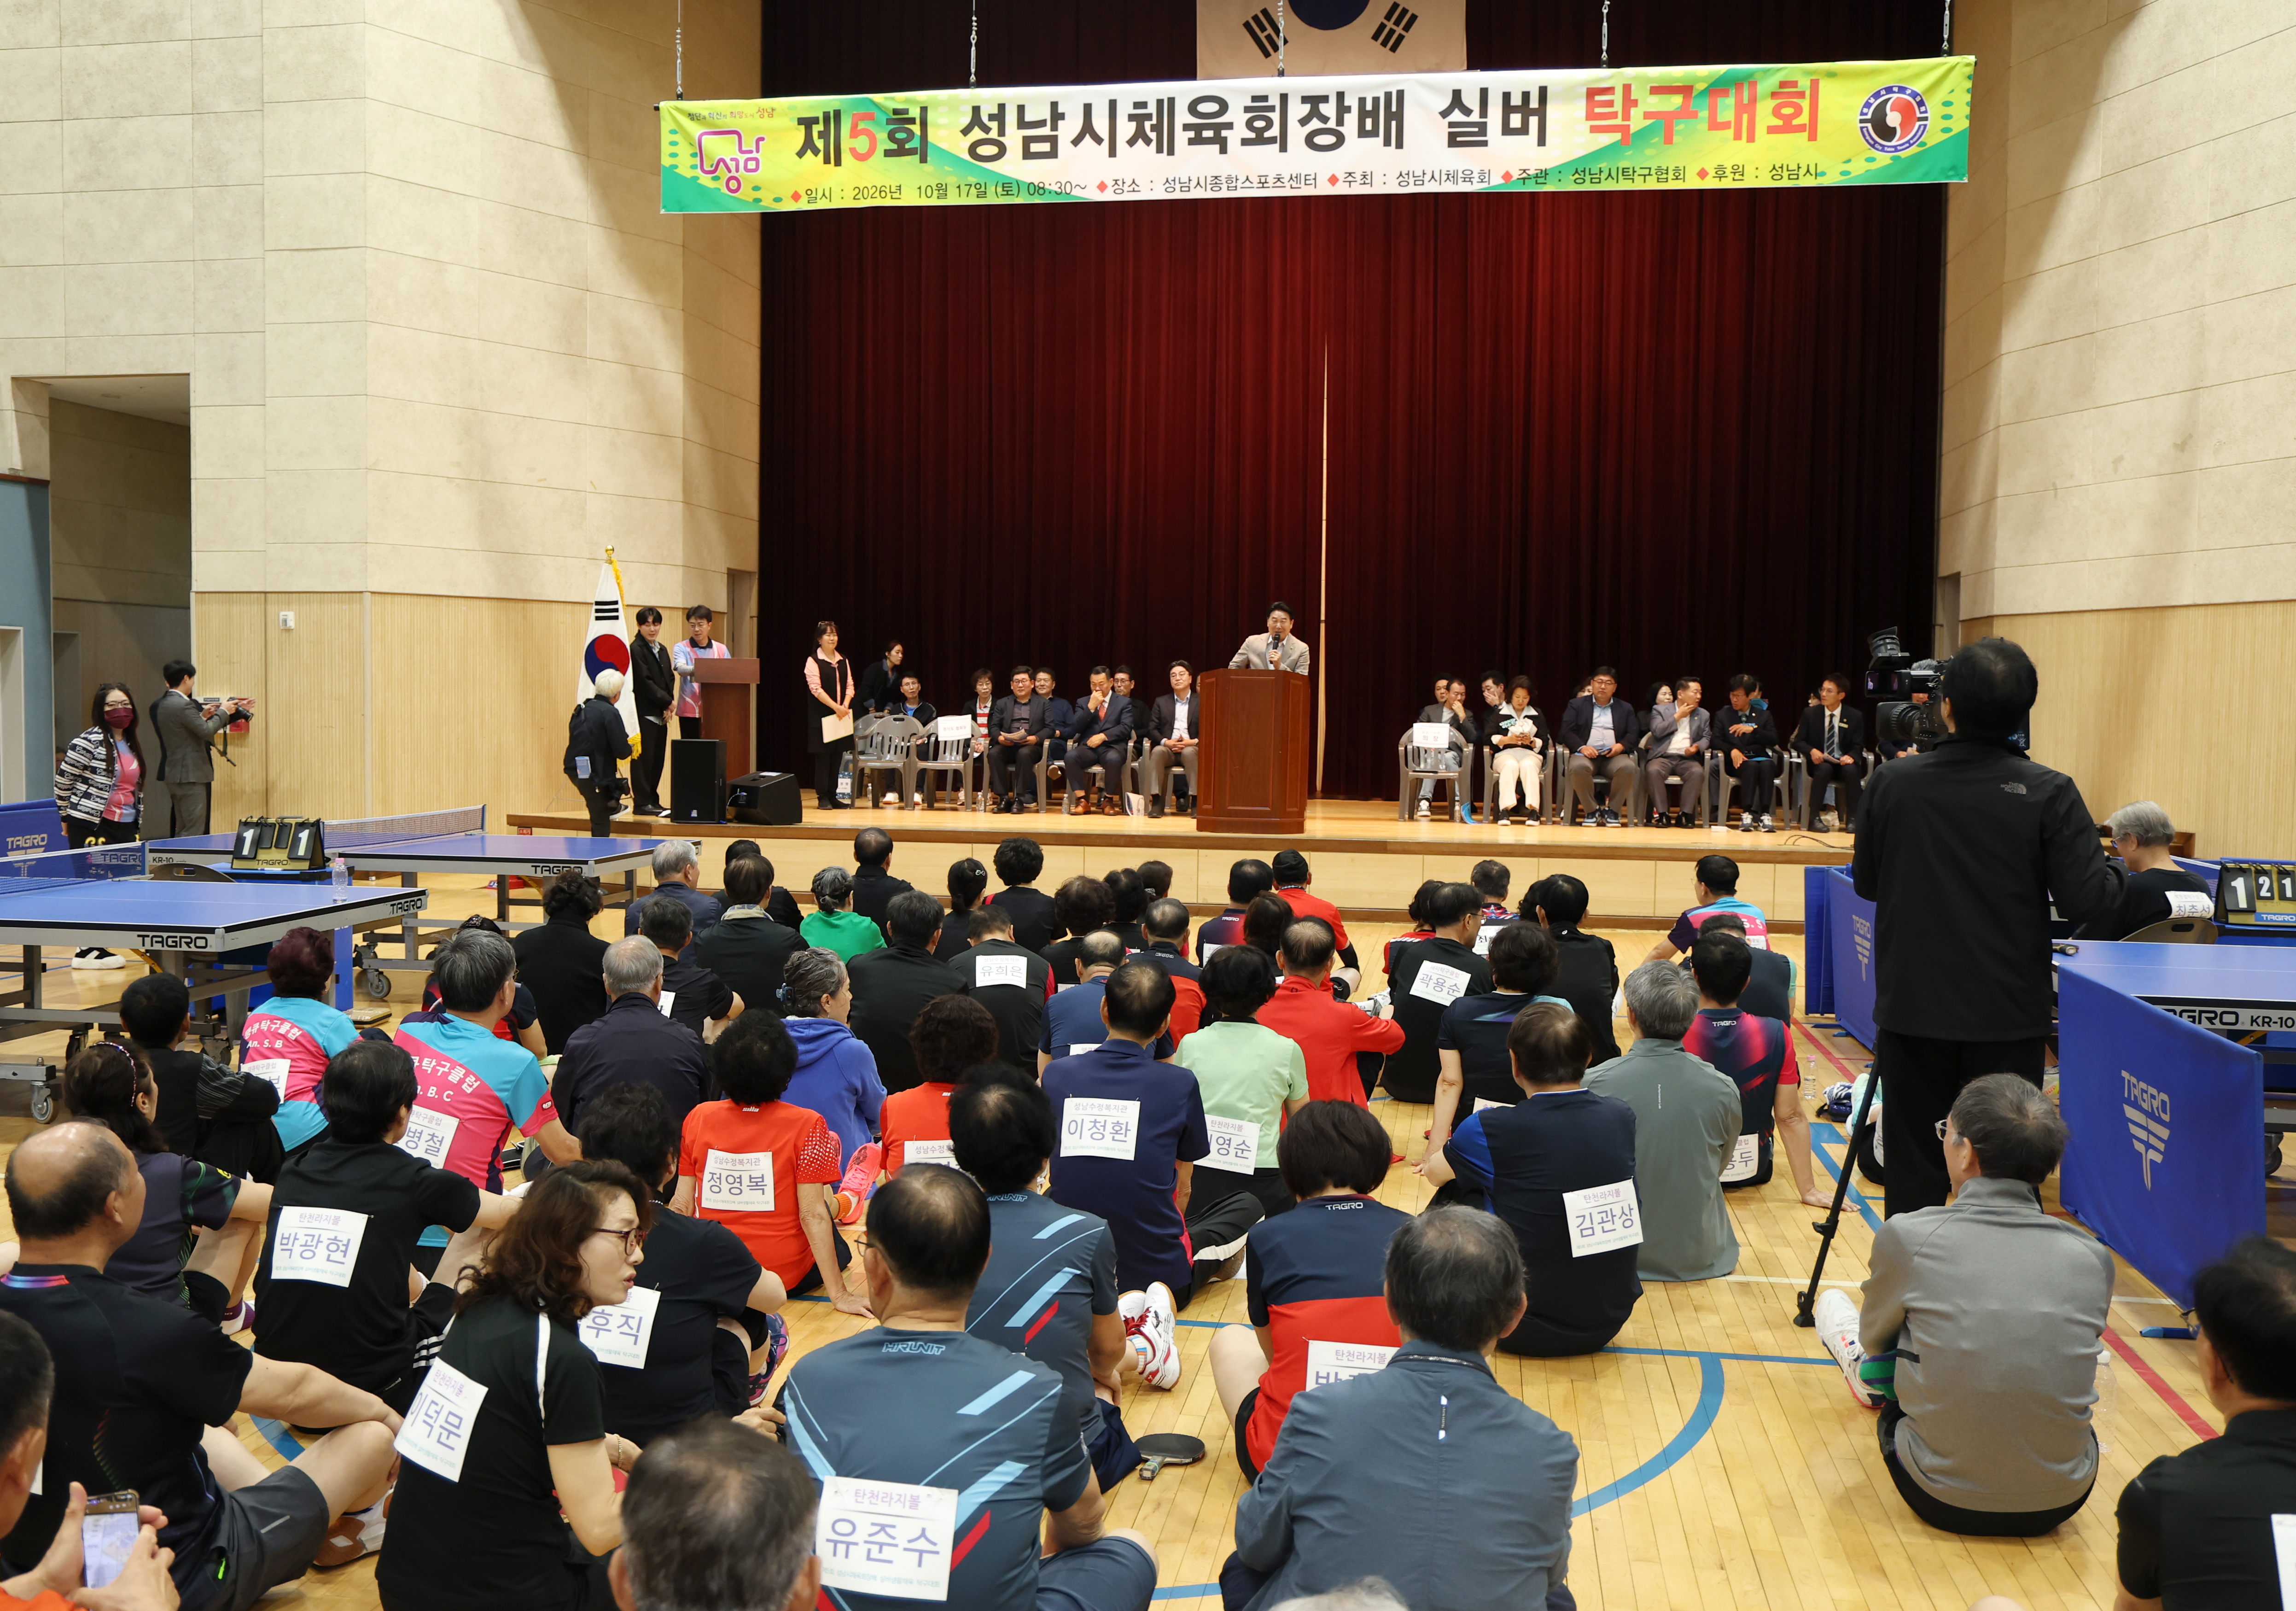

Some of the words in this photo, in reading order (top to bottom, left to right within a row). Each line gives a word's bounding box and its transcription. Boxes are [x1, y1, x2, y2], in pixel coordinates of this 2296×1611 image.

[756, 107, 776, 118] 성남
[795, 106, 928, 167] 제5회
[960, 89, 1404, 163] 성남시체육회장배
[1438, 86, 1548, 148] 실버
[1585, 78, 1820, 146] 탁구대회
[1342, 171, 1373, 188] 주최
[1396, 169, 1491, 187] 성남시체육회
[1517, 169, 1549, 185] 주관
[1572, 166, 1686, 184] 성남시탁구협회
[1713, 164, 1746, 181] 후원
[1769, 163, 1818, 181] 성남시
[805, 187, 833, 204] 일시
[852, 185, 902, 201] 2026년
[917, 183, 948, 200] 10월
[956, 181, 988, 198] 17일
[995, 181, 1020, 198] (토)
[1027, 181, 1087, 196] 08:30~
[1111, 178, 1142, 194] 장소
[1163, 173, 1317, 193] 성남시종합스포츠센터
[6, 834, 48, 849] TAGRO
[242, 829, 254, 855] 1
[298, 829, 309, 855] 1
[2232, 877, 2247, 908] 1
[2259, 876, 2271, 896] 2
[2282, 877, 2293, 898] 1
[390, 898, 422, 914] TAGRO
[137, 934, 208, 949] TAGRO
[980, 965, 1023, 978] 유희은
[1420, 974, 1461, 998] 곽용순
[2163, 1009, 2239, 1026] GRO
[2250, 1015, 2295, 1028] KR-10
[443, 1091, 454, 1101] C
[2121, 1070, 2170, 1122] TAGRO
[1074, 1103, 1128, 1113] 성남수정복지관
[1068, 1118, 1131, 1142] 이청환
[1211, 1120, 1243, 1132] 탄천라지볼
[397, 1127, 444, 1157] 병철
[714, 1155, 761, 1167] 성남수정복지관
[707, 1172, 767, 1196] 정영복
[1584, 1188, 1621, 1203] 탄천라지볼
[299, 1213, 340, 1226] 탄천라지볼
[1576, 1203, 1633, 1238] 김관상
[280, 1232, 351, 1265] 박광현
[579, 1309, 643, 1345] 후직
[1335, 1349, 1387, 1365] 탄천라지볼
[434, 1369, 465, 1397] 탄천라지볼
[410, 1391, 463, 1451] 이덕문
[855, 1488, 921, 1510] 탄천라지볼
[826, 1518, 940, 1568] 유준수
